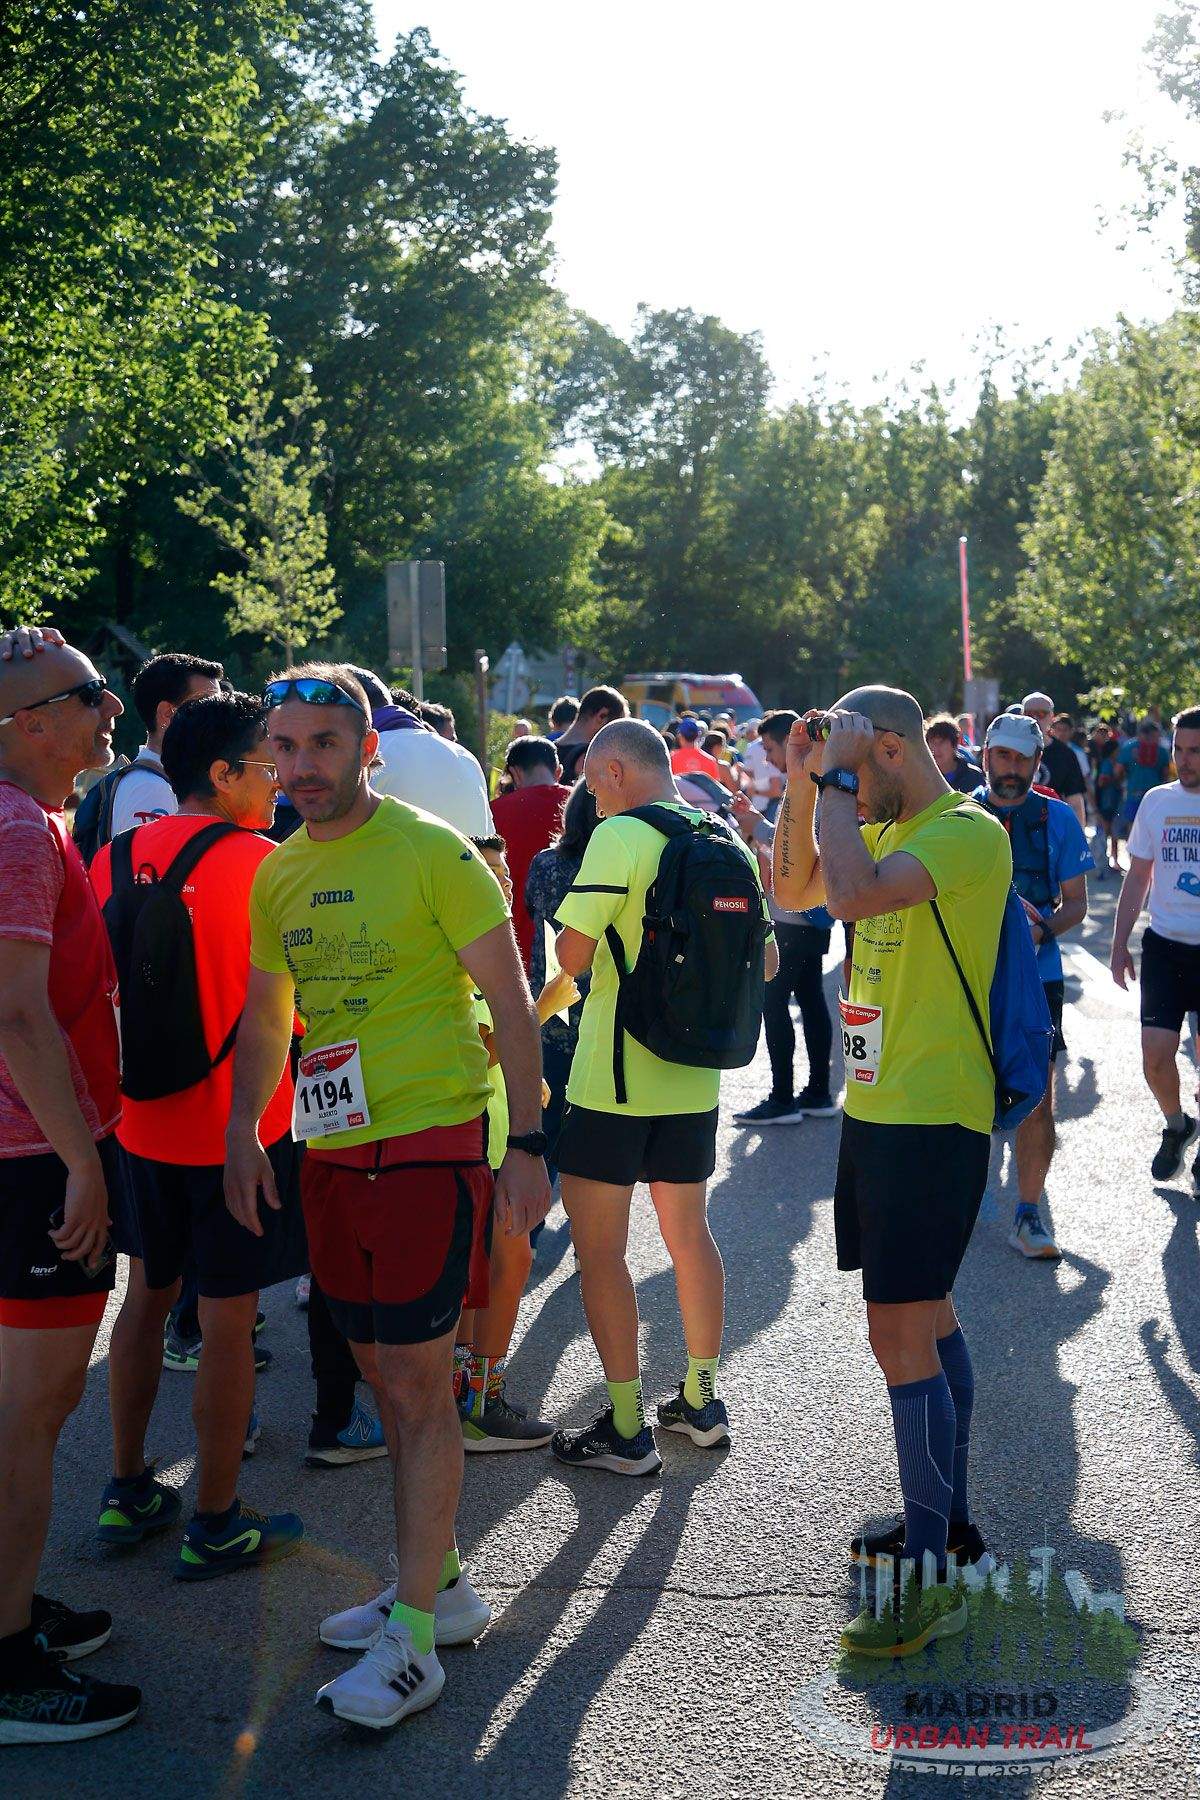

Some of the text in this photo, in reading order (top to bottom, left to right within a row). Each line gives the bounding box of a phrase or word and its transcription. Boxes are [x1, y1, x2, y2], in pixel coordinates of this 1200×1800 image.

[1162, 846, 1179, 862] DEL
[714, 900, 746, 909] PENOSIL
[289, 927, 313, 947] 2023
[855, 1009, 876, 1018] Campo
[335, 1048, 354, 1057] Campo
[841, 1029, 867, 1060] 98
[299, 1076, 354, 1114] 1194
